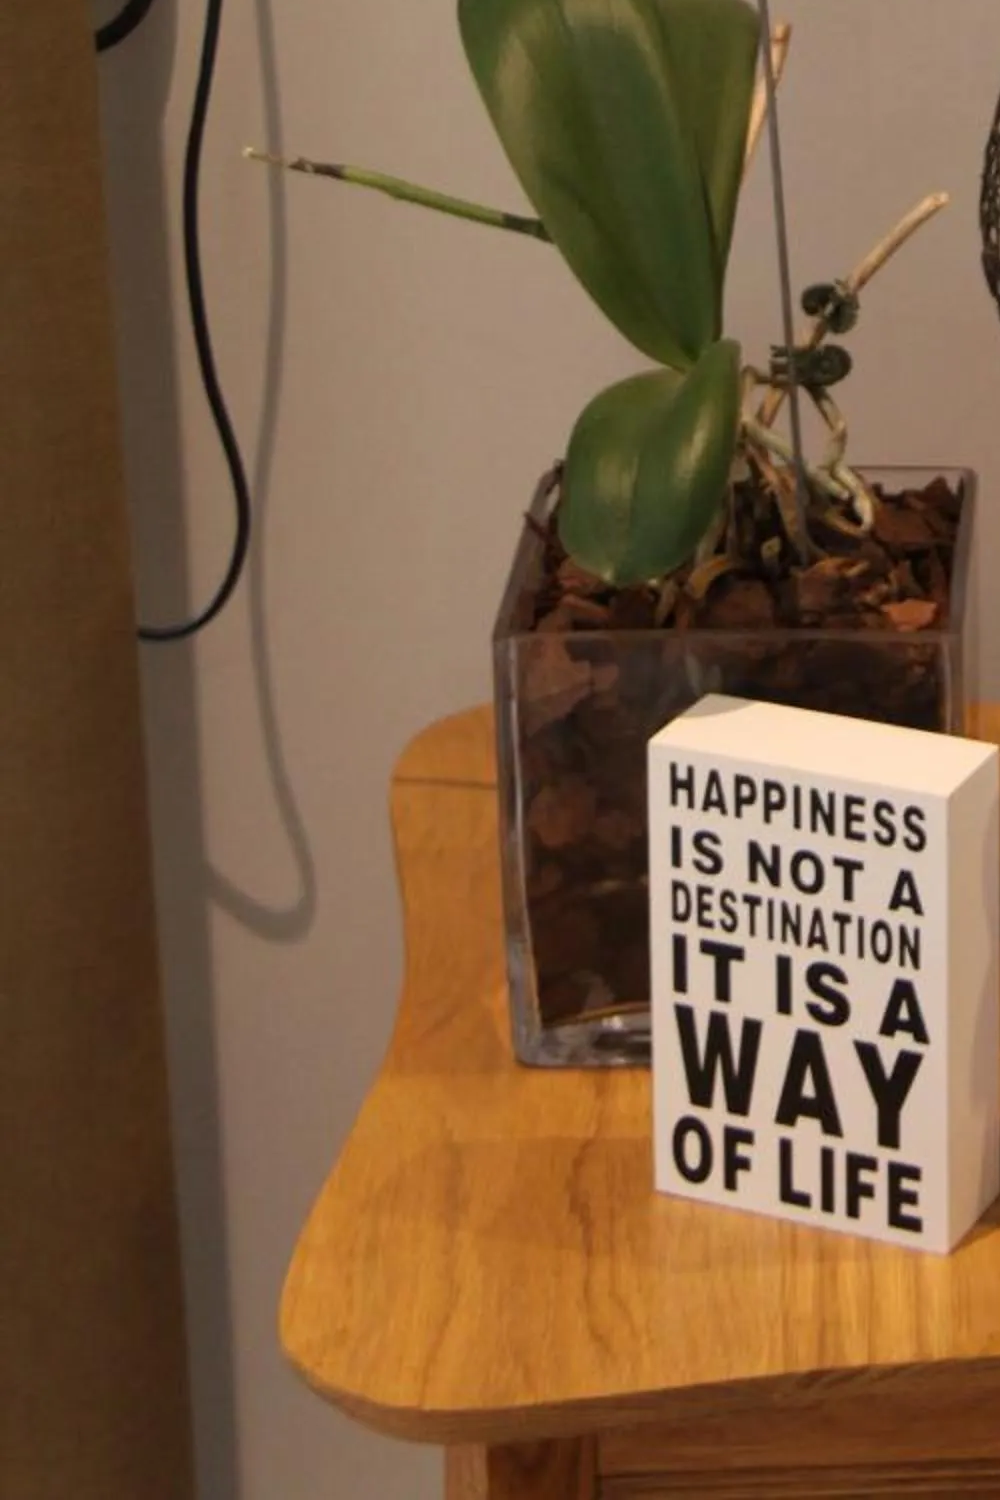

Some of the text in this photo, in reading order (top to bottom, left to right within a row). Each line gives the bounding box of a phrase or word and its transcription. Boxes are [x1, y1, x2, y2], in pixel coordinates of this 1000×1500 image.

[669, 762, 927, 853] HAPPINESS
[671, 825, 924, 916] IS NOT A
[671, 879, 921, 971] DESTINATION
[672, 933, 930, 1045] IT IS A
[673, 1003, 924, 1151] WAY
[672, 1115, 923, 1233] OF LIFE
